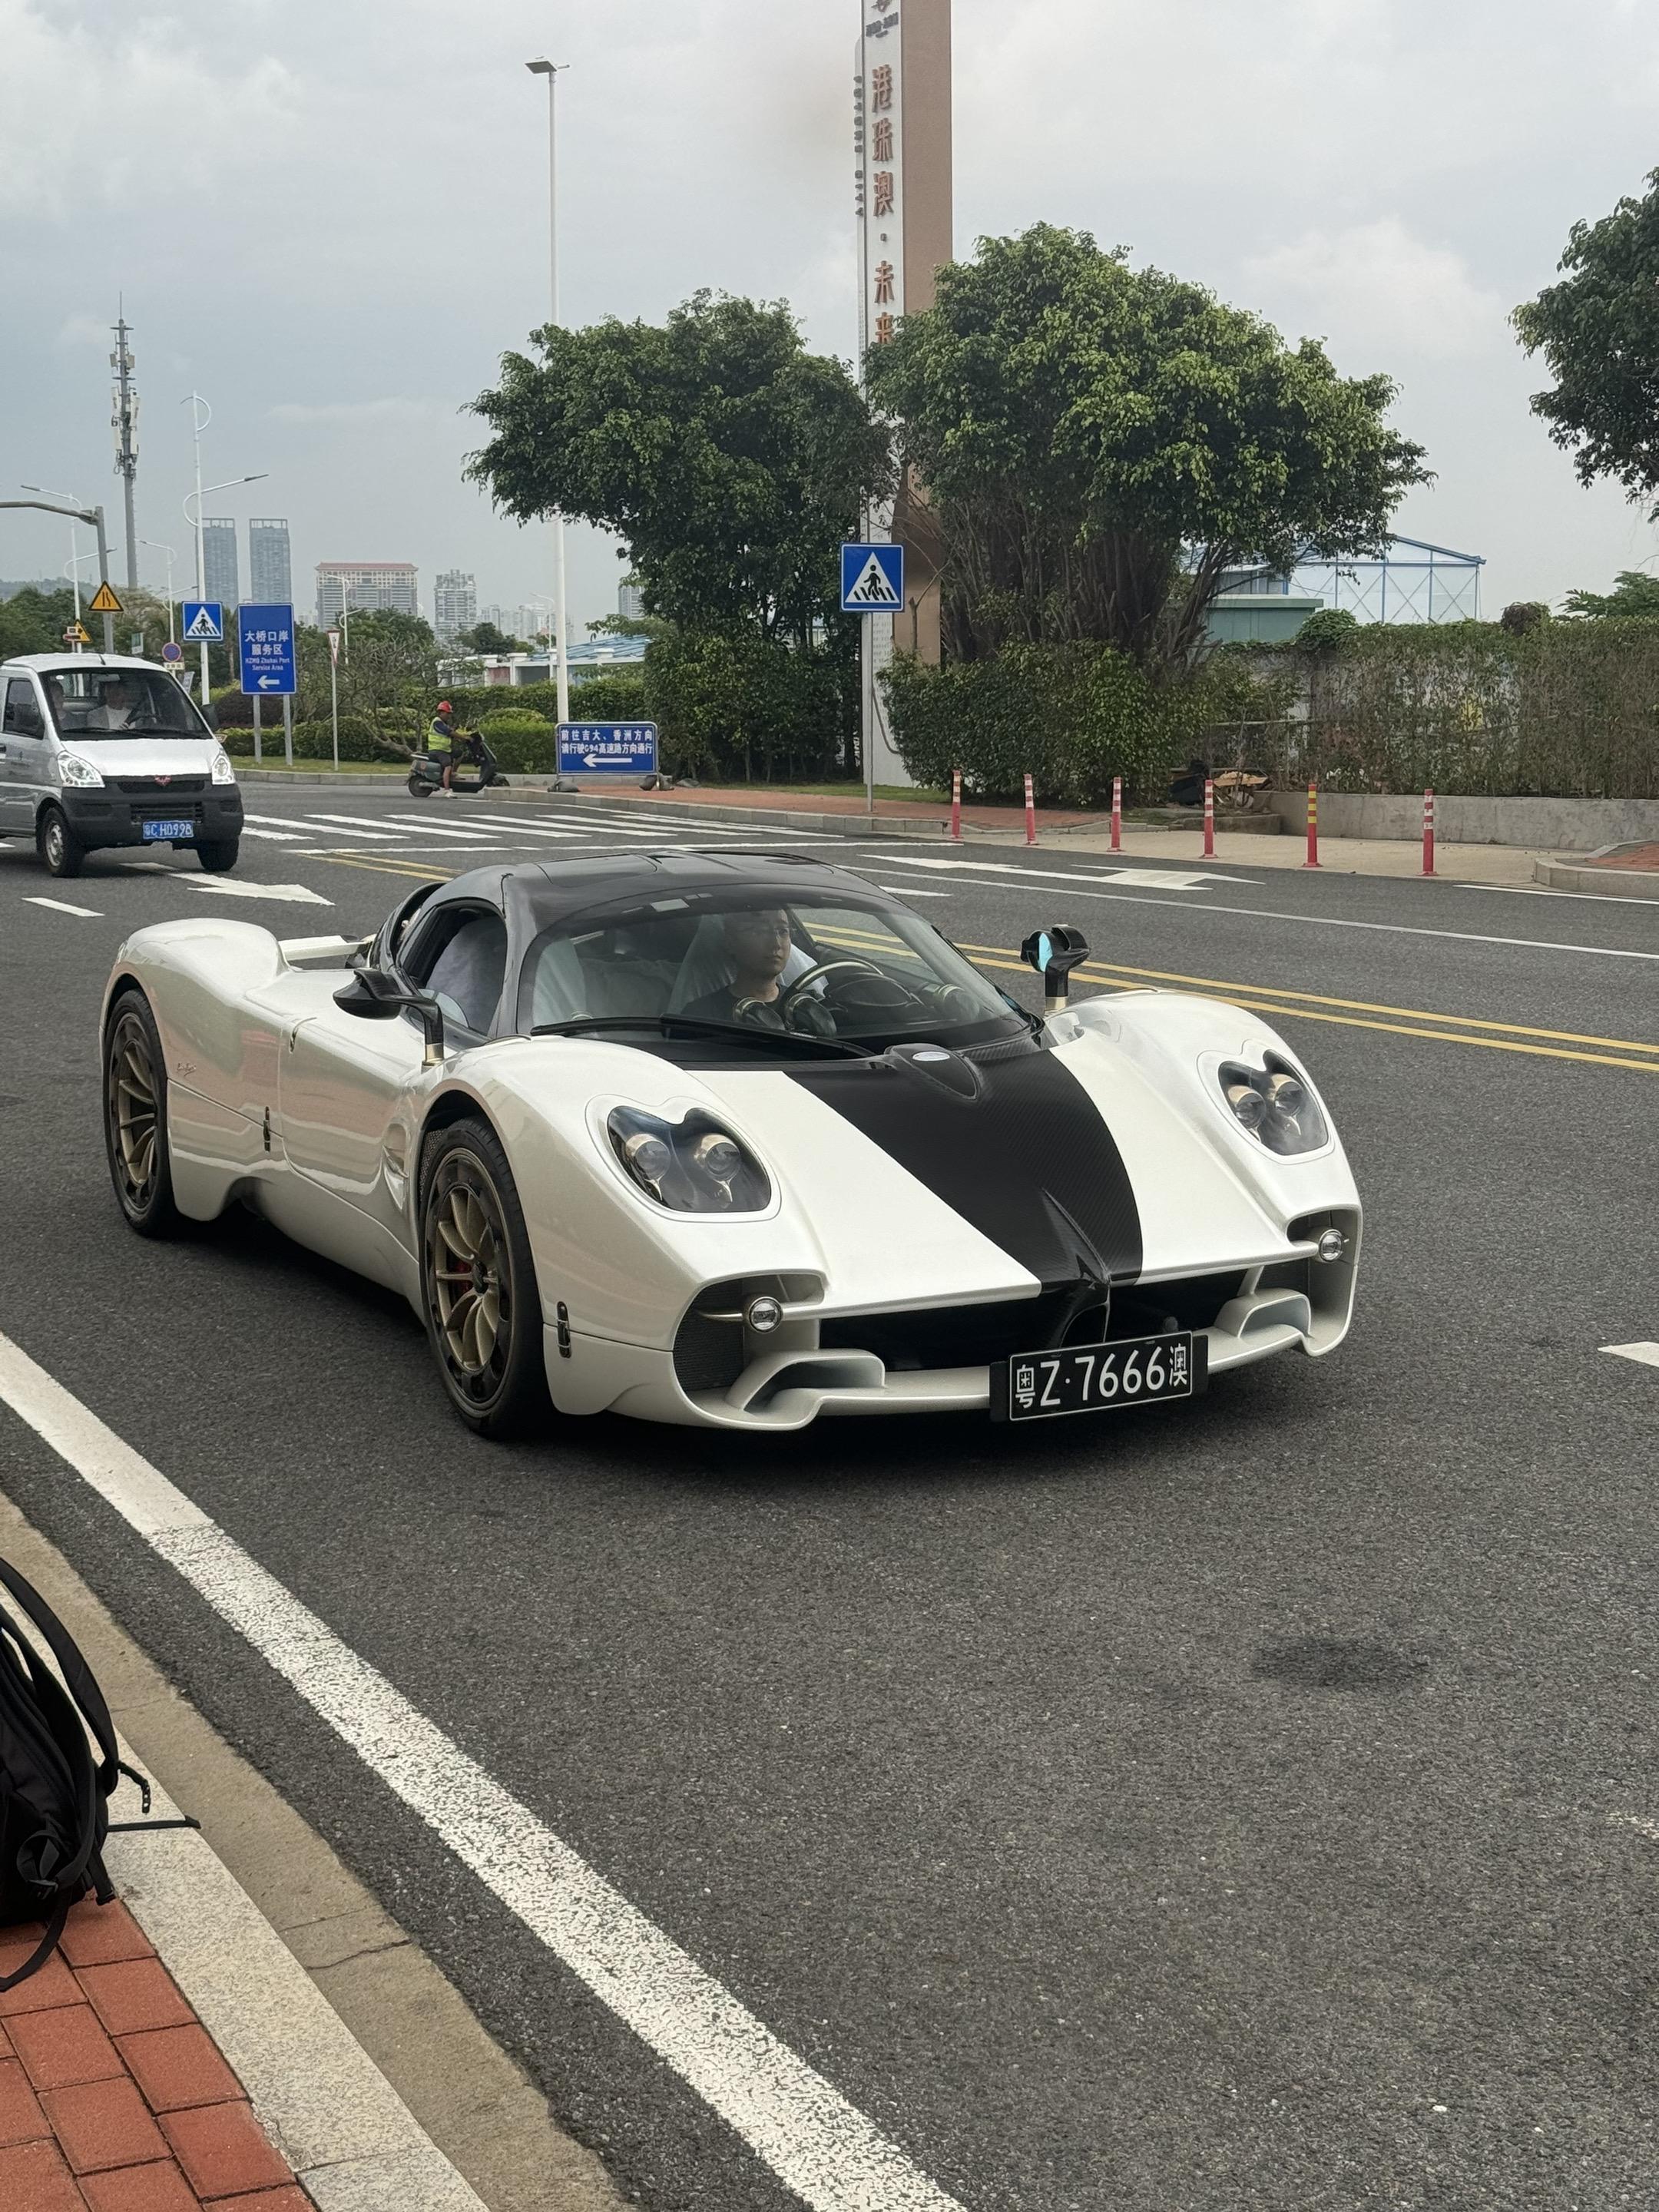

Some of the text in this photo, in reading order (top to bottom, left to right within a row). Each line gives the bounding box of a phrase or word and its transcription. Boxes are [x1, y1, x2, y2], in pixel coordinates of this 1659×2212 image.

[244, 631, 290, 642] 大桥口岸
[252, 644, 283, 655] 服务区
[1015, 1343, 1187, 1409] 粤Z·7666澳
